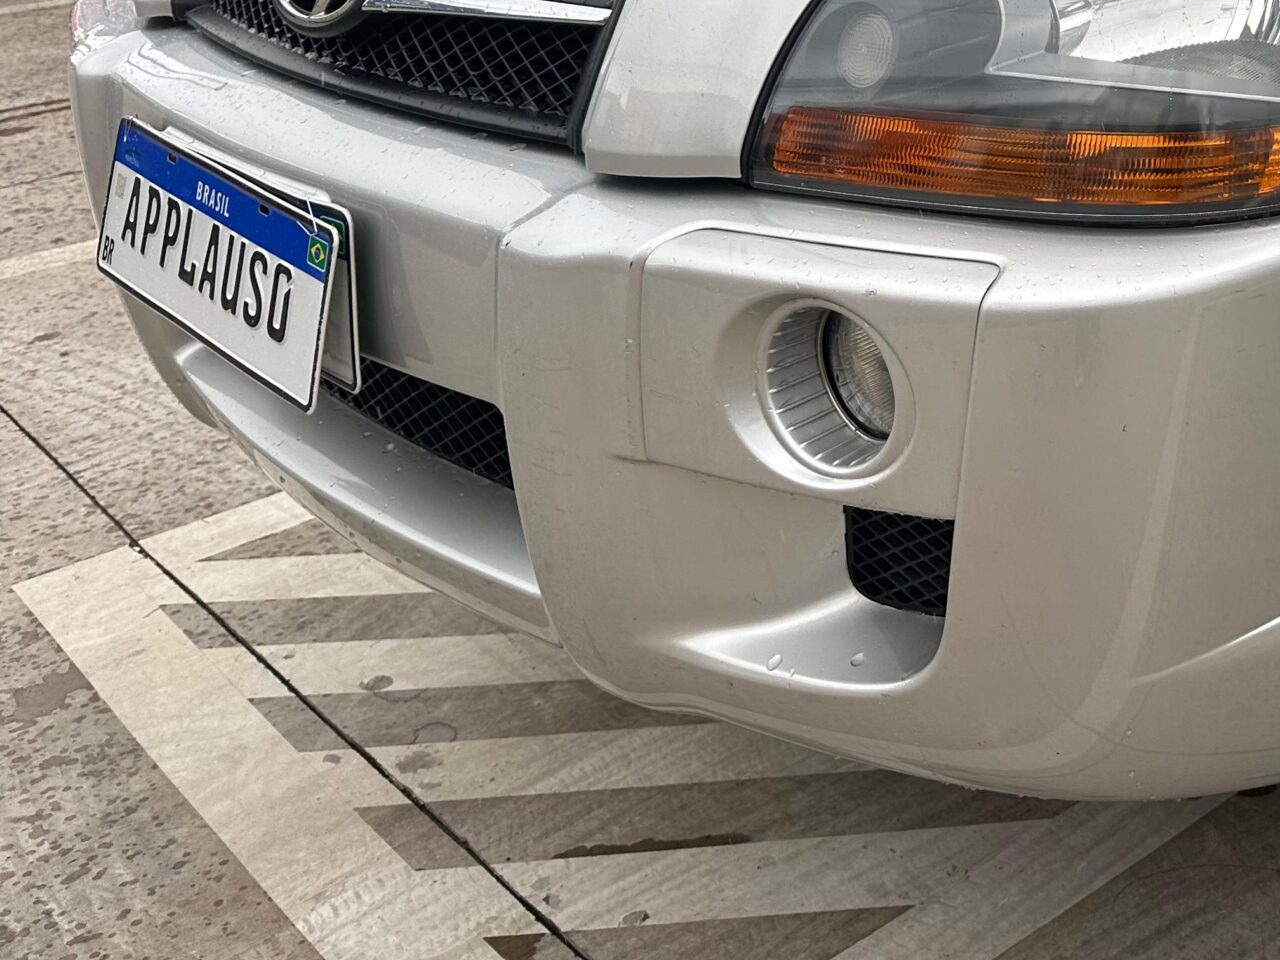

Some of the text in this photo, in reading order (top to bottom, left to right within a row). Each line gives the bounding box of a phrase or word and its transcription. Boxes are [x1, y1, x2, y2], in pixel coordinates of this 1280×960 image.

[195, 180, 231, 218] BRASIL
[101, 237, 115, 266] BR
[121, 176, 293, 343] APPLAUSO
